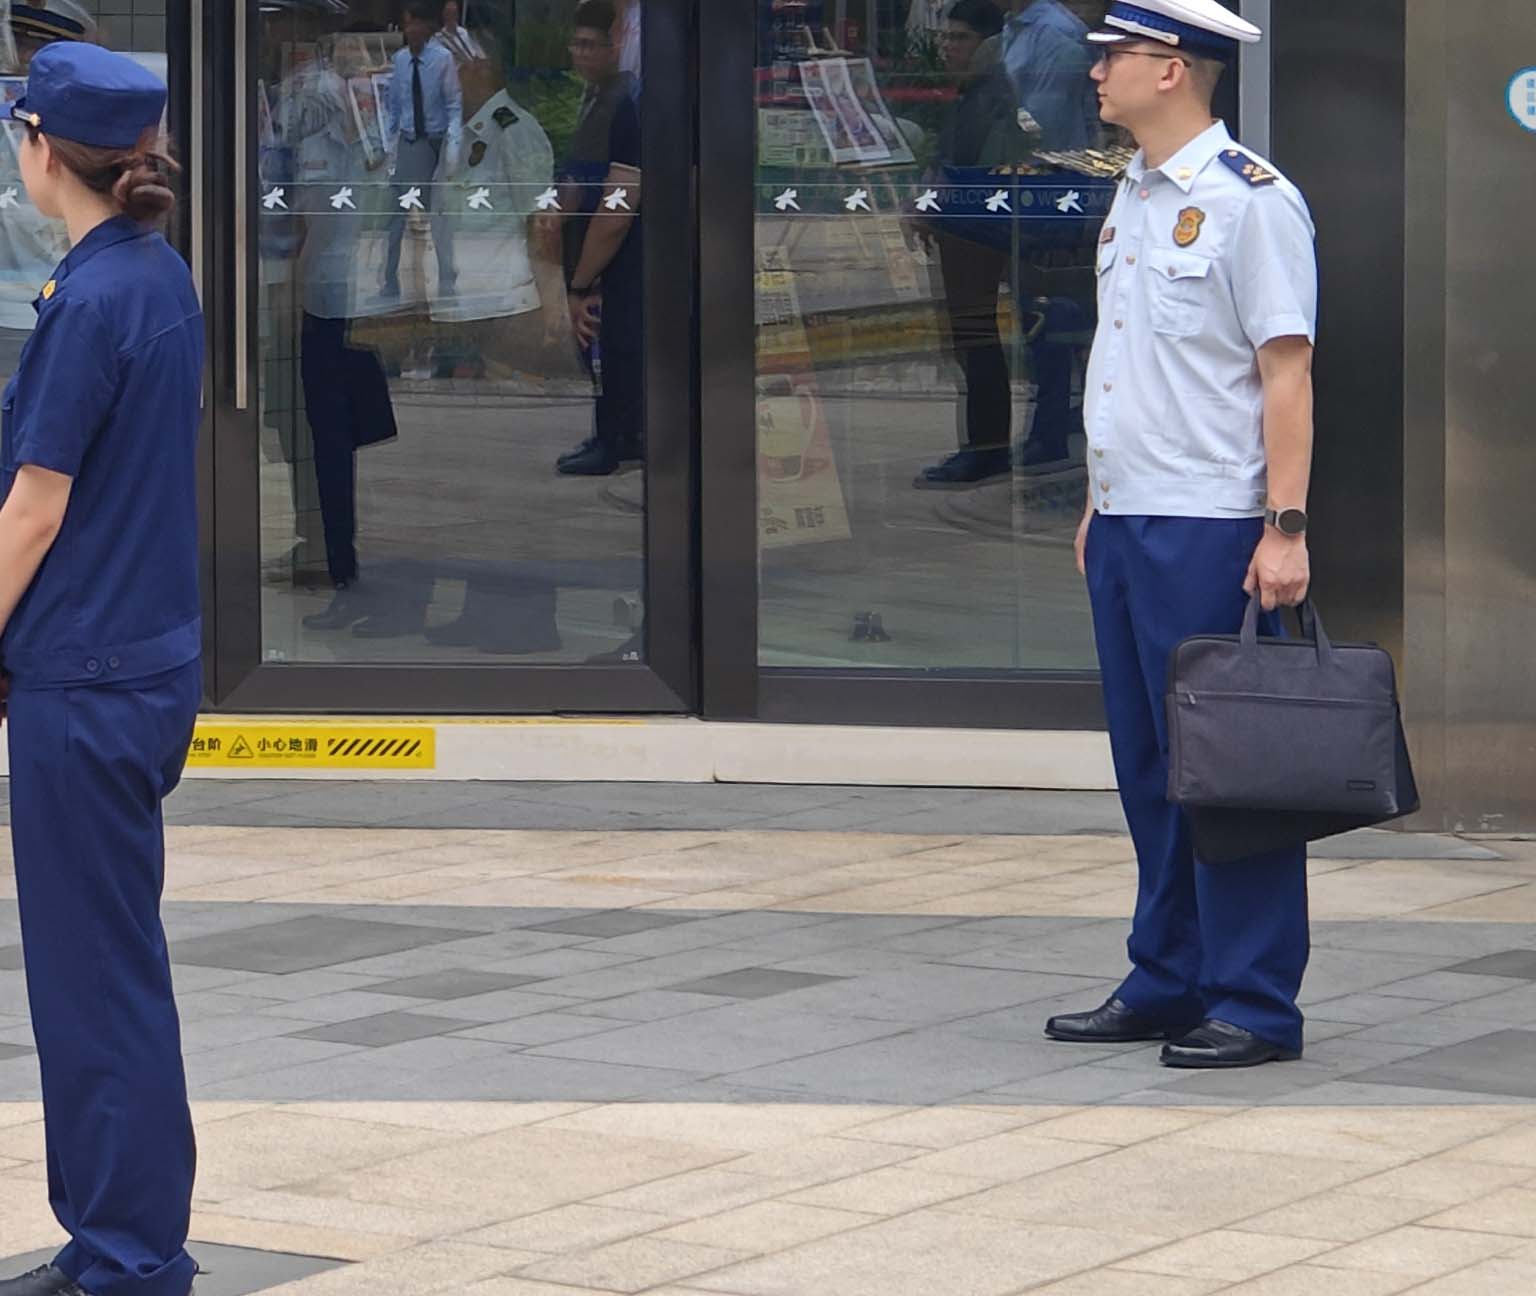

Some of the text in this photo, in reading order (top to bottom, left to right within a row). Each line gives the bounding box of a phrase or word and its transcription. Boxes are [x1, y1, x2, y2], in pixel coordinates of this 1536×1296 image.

[191, 737, 319, 753] 台阶 小心地滑
